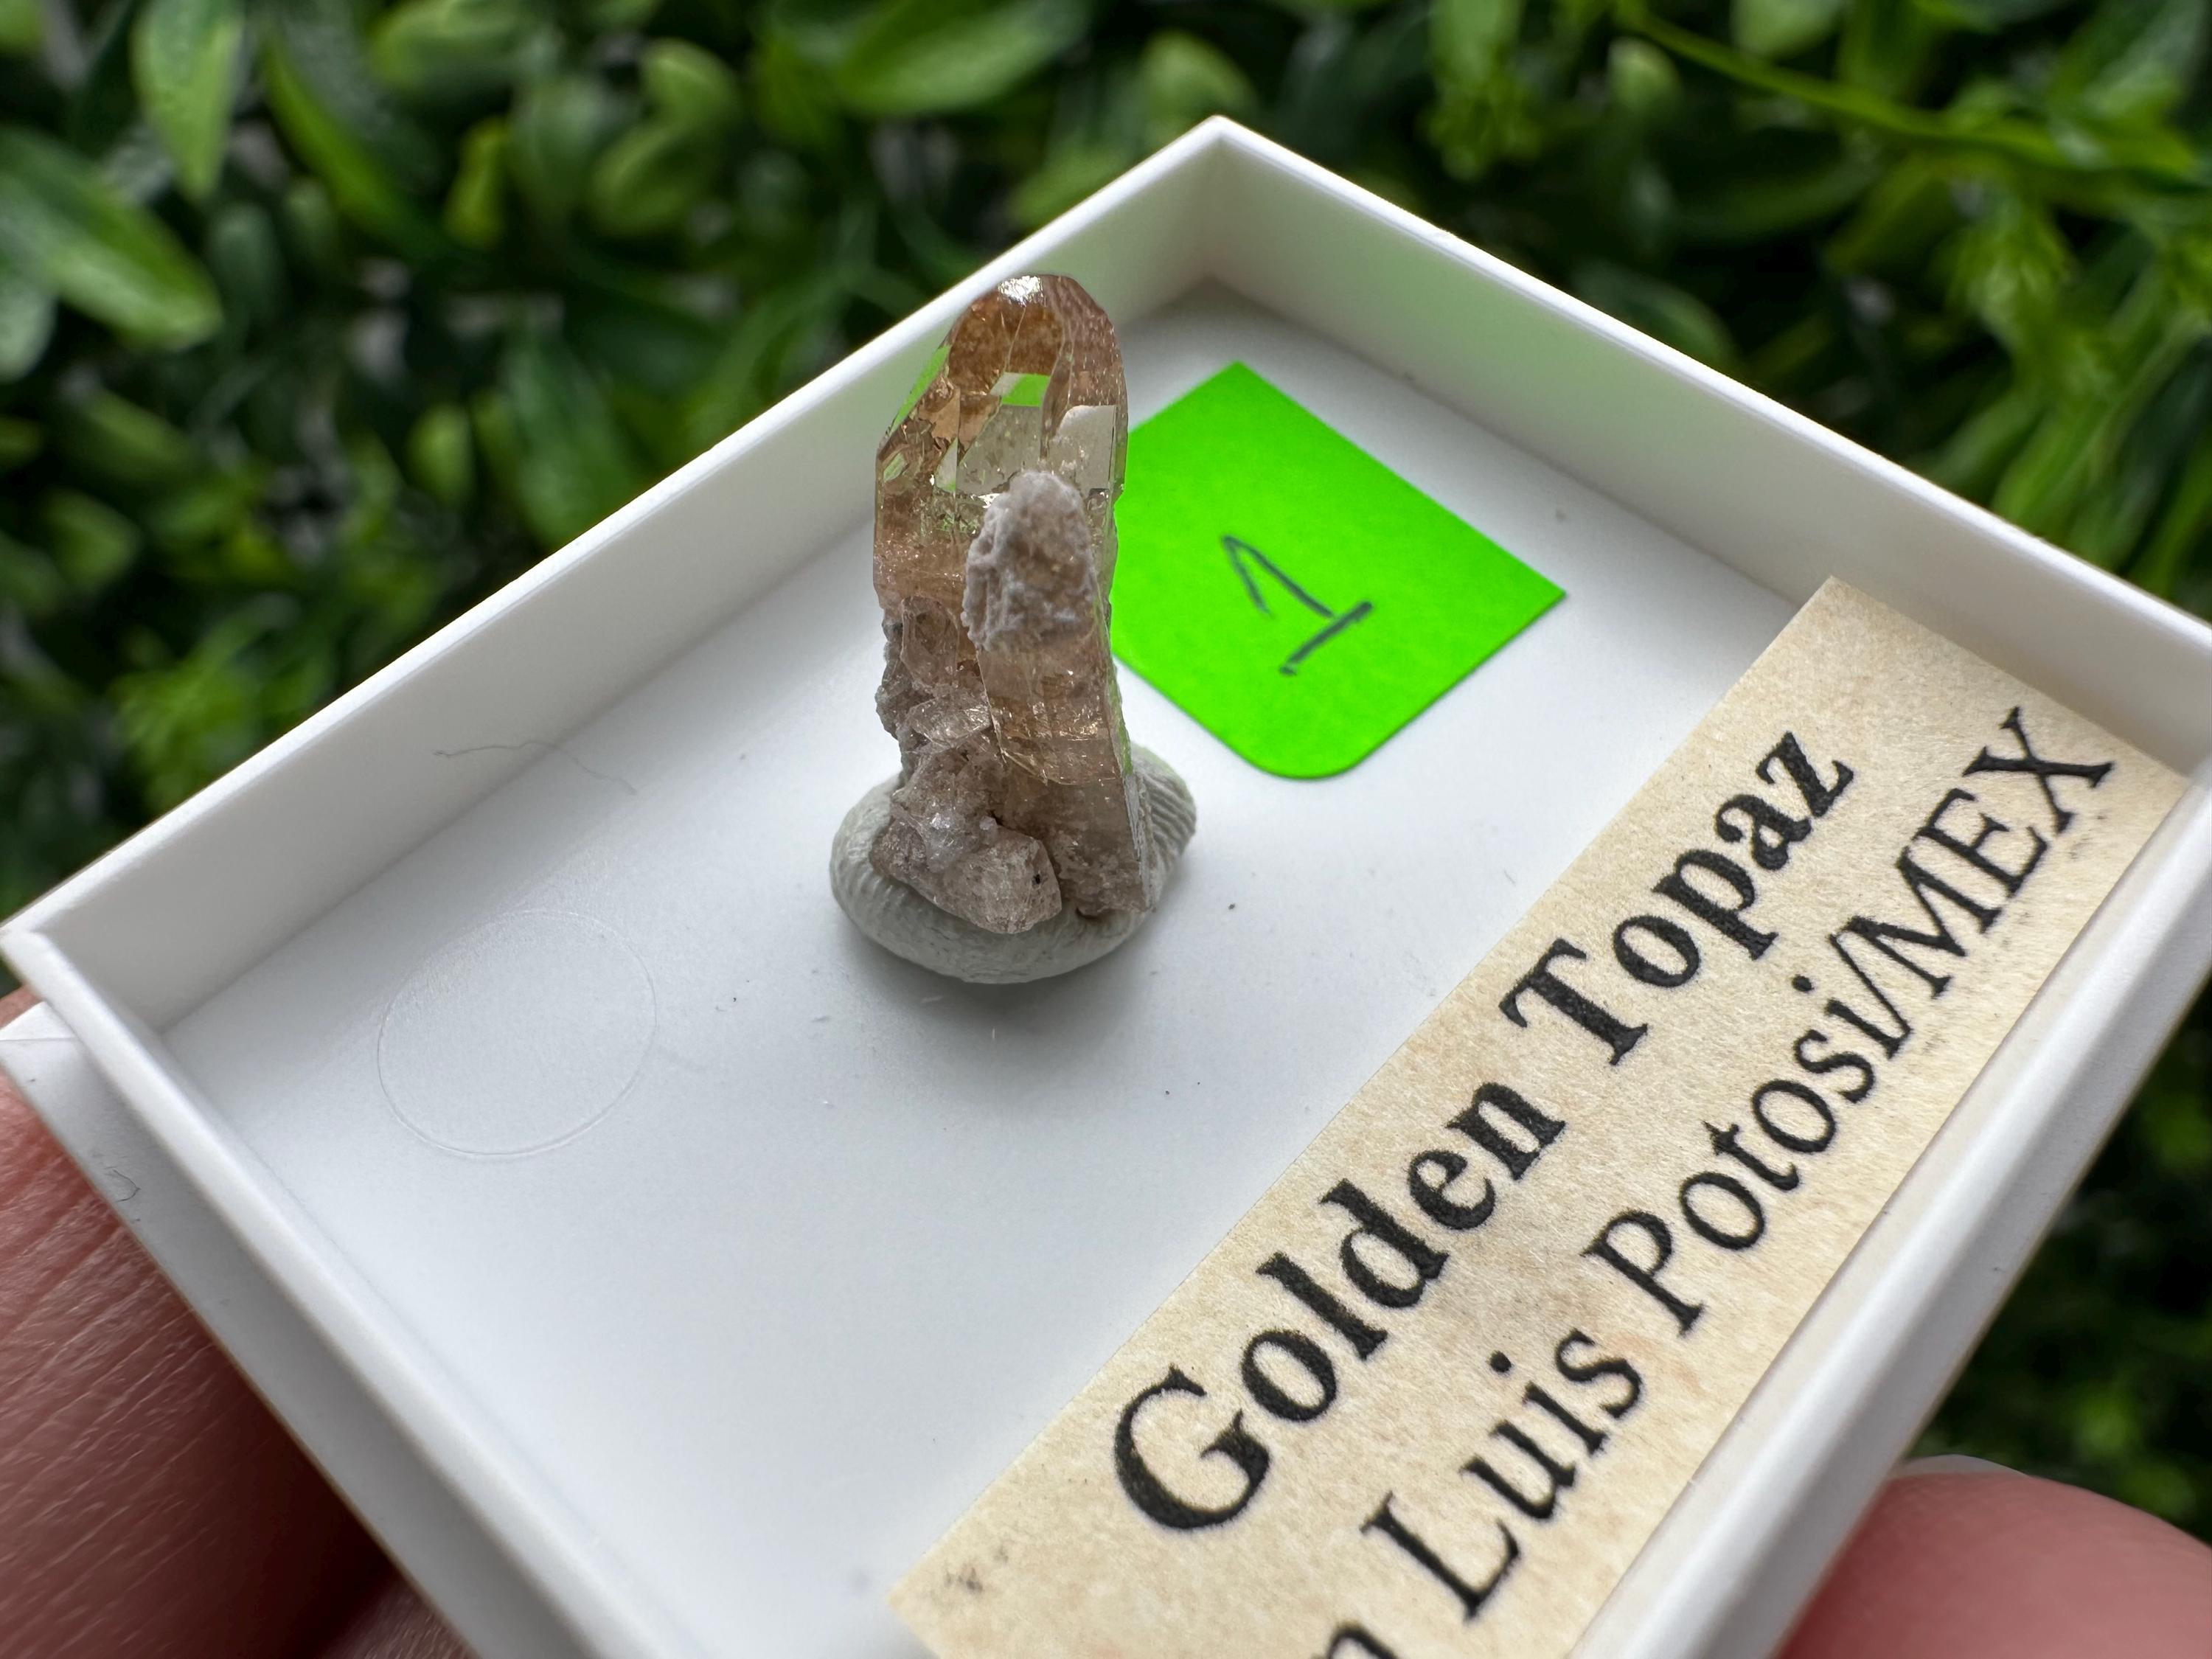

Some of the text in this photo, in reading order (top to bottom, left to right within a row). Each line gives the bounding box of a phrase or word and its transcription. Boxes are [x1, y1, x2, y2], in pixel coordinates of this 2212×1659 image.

[1220, 535, 1374, 676] 1
[1114, 731, 1854, 1532] Golden Topaz
[1360, 706, 2115, 1620] Luis Potosi/MEX
